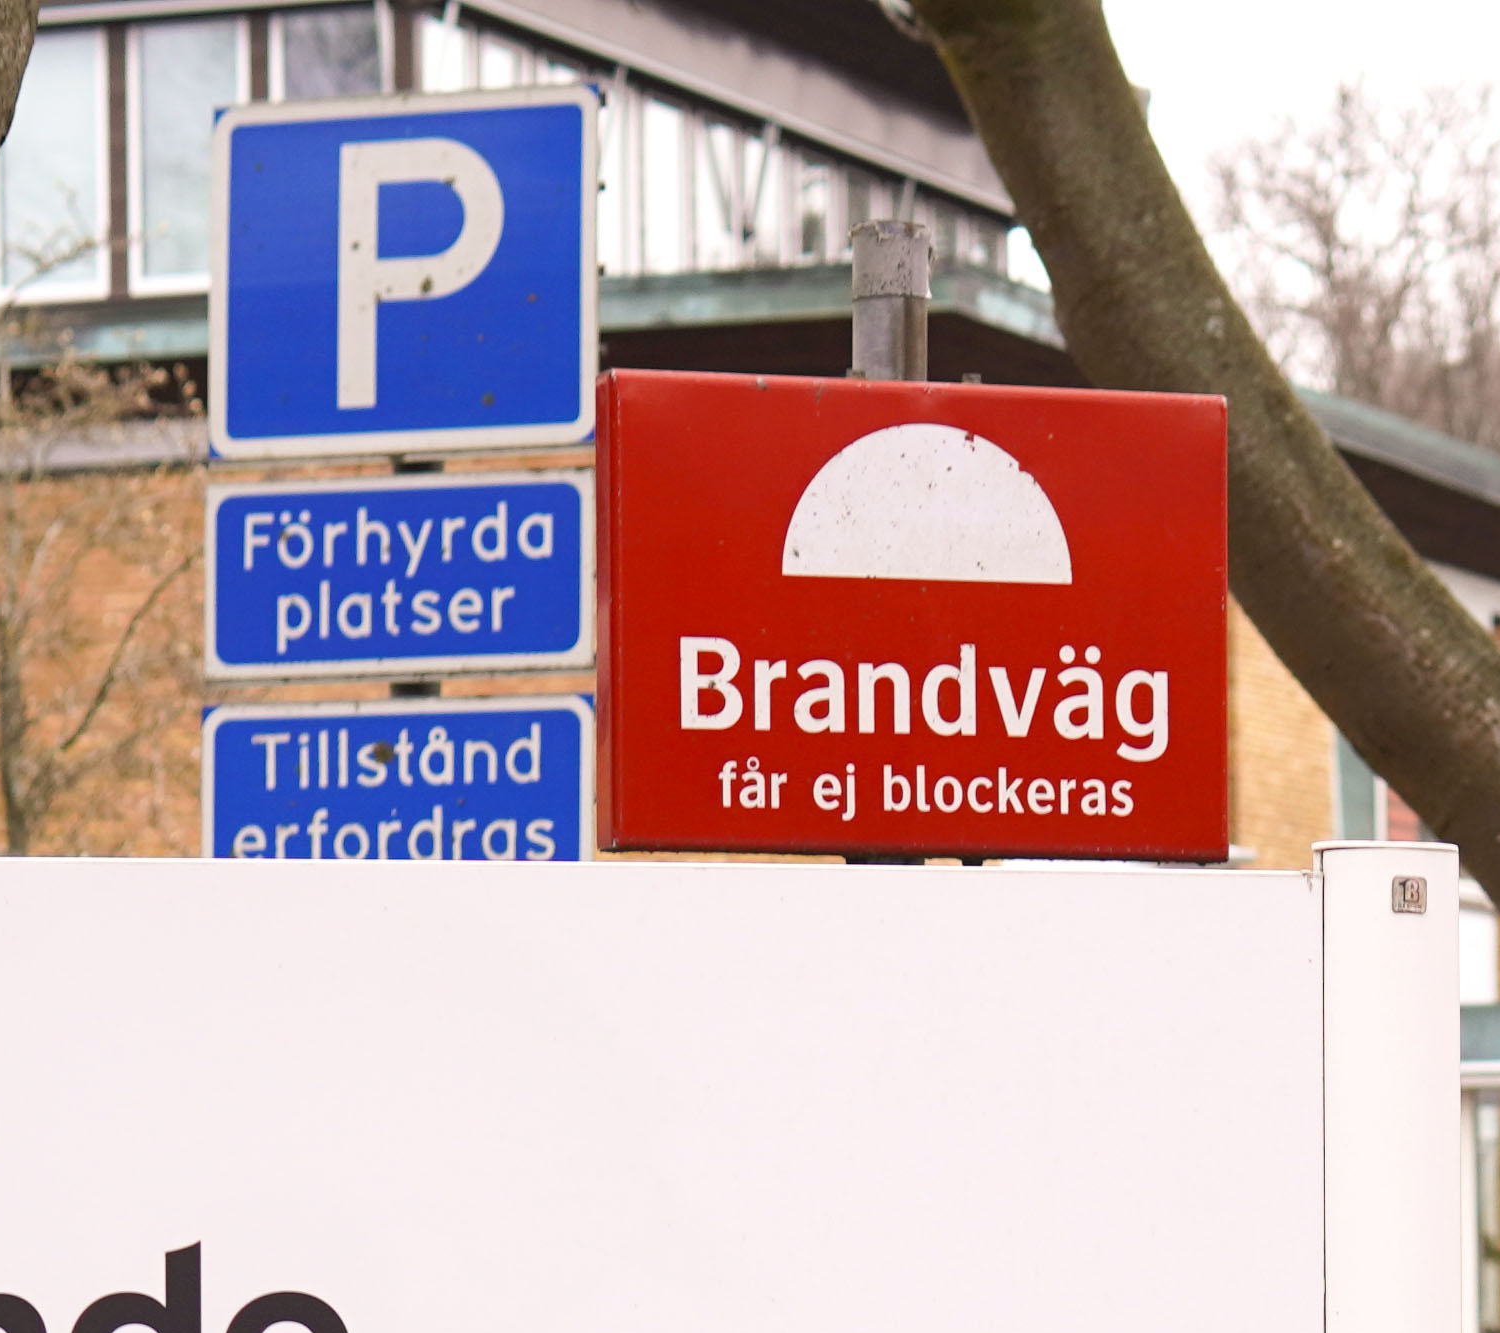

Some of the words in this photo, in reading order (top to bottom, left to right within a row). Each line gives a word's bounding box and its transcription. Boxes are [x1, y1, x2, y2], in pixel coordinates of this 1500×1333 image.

[336, 136, 505, 411] P
[242, 500, 554, 578] Förhyrda
[275, 578, 516, 652] platser
[678, 635, 1170, 763] Brandväg
[250, 721, 542, 791] Tillstånd
[718, 755, 789, 810] får
[811, 762, 857, 822] ej
[882, 764, 1135, 819] blockeras
[232, 804, 556, 860] erfordras
